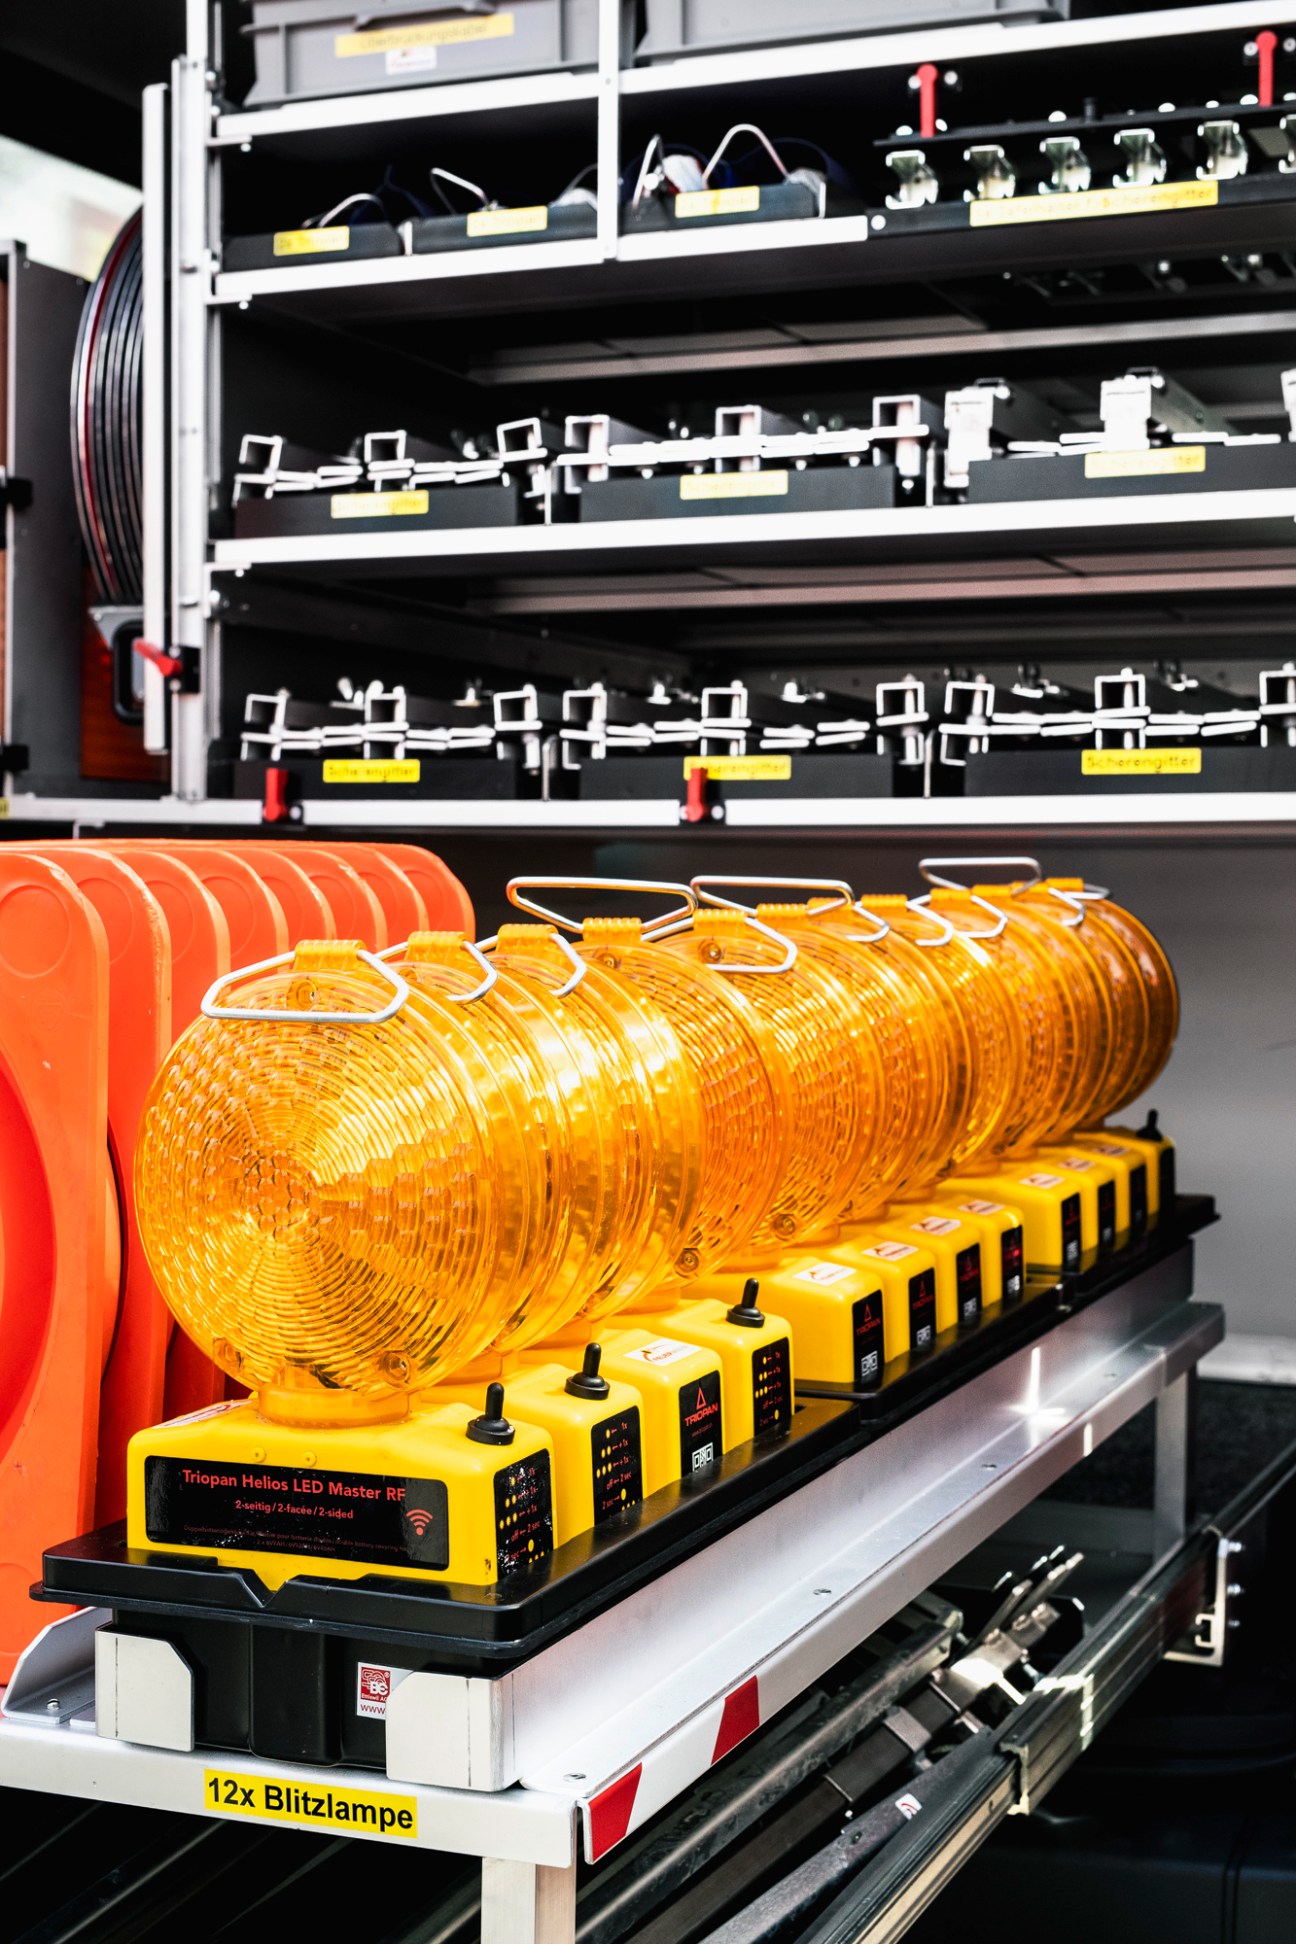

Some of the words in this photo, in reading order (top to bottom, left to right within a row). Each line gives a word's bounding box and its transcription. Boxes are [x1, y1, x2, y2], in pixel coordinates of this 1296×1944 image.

[684, 1402, 719, 1427] TRIOPAN
[182, 1469, 237, 1489] Triopan
[242, 1474, 289, 1491] Helios
[293, 1478, 324, 1494] LED
[328, 1481, 381, 1499] Master
[386, 1487, 406, 1501] RF
[235, 1499, 271, 1514] 2-seitig
[319, 1507, 354, 1519] 2-sided
[208, 1777, 256, 1808] 12x
[264, 1784, 413, 1832] Blitzlampe
